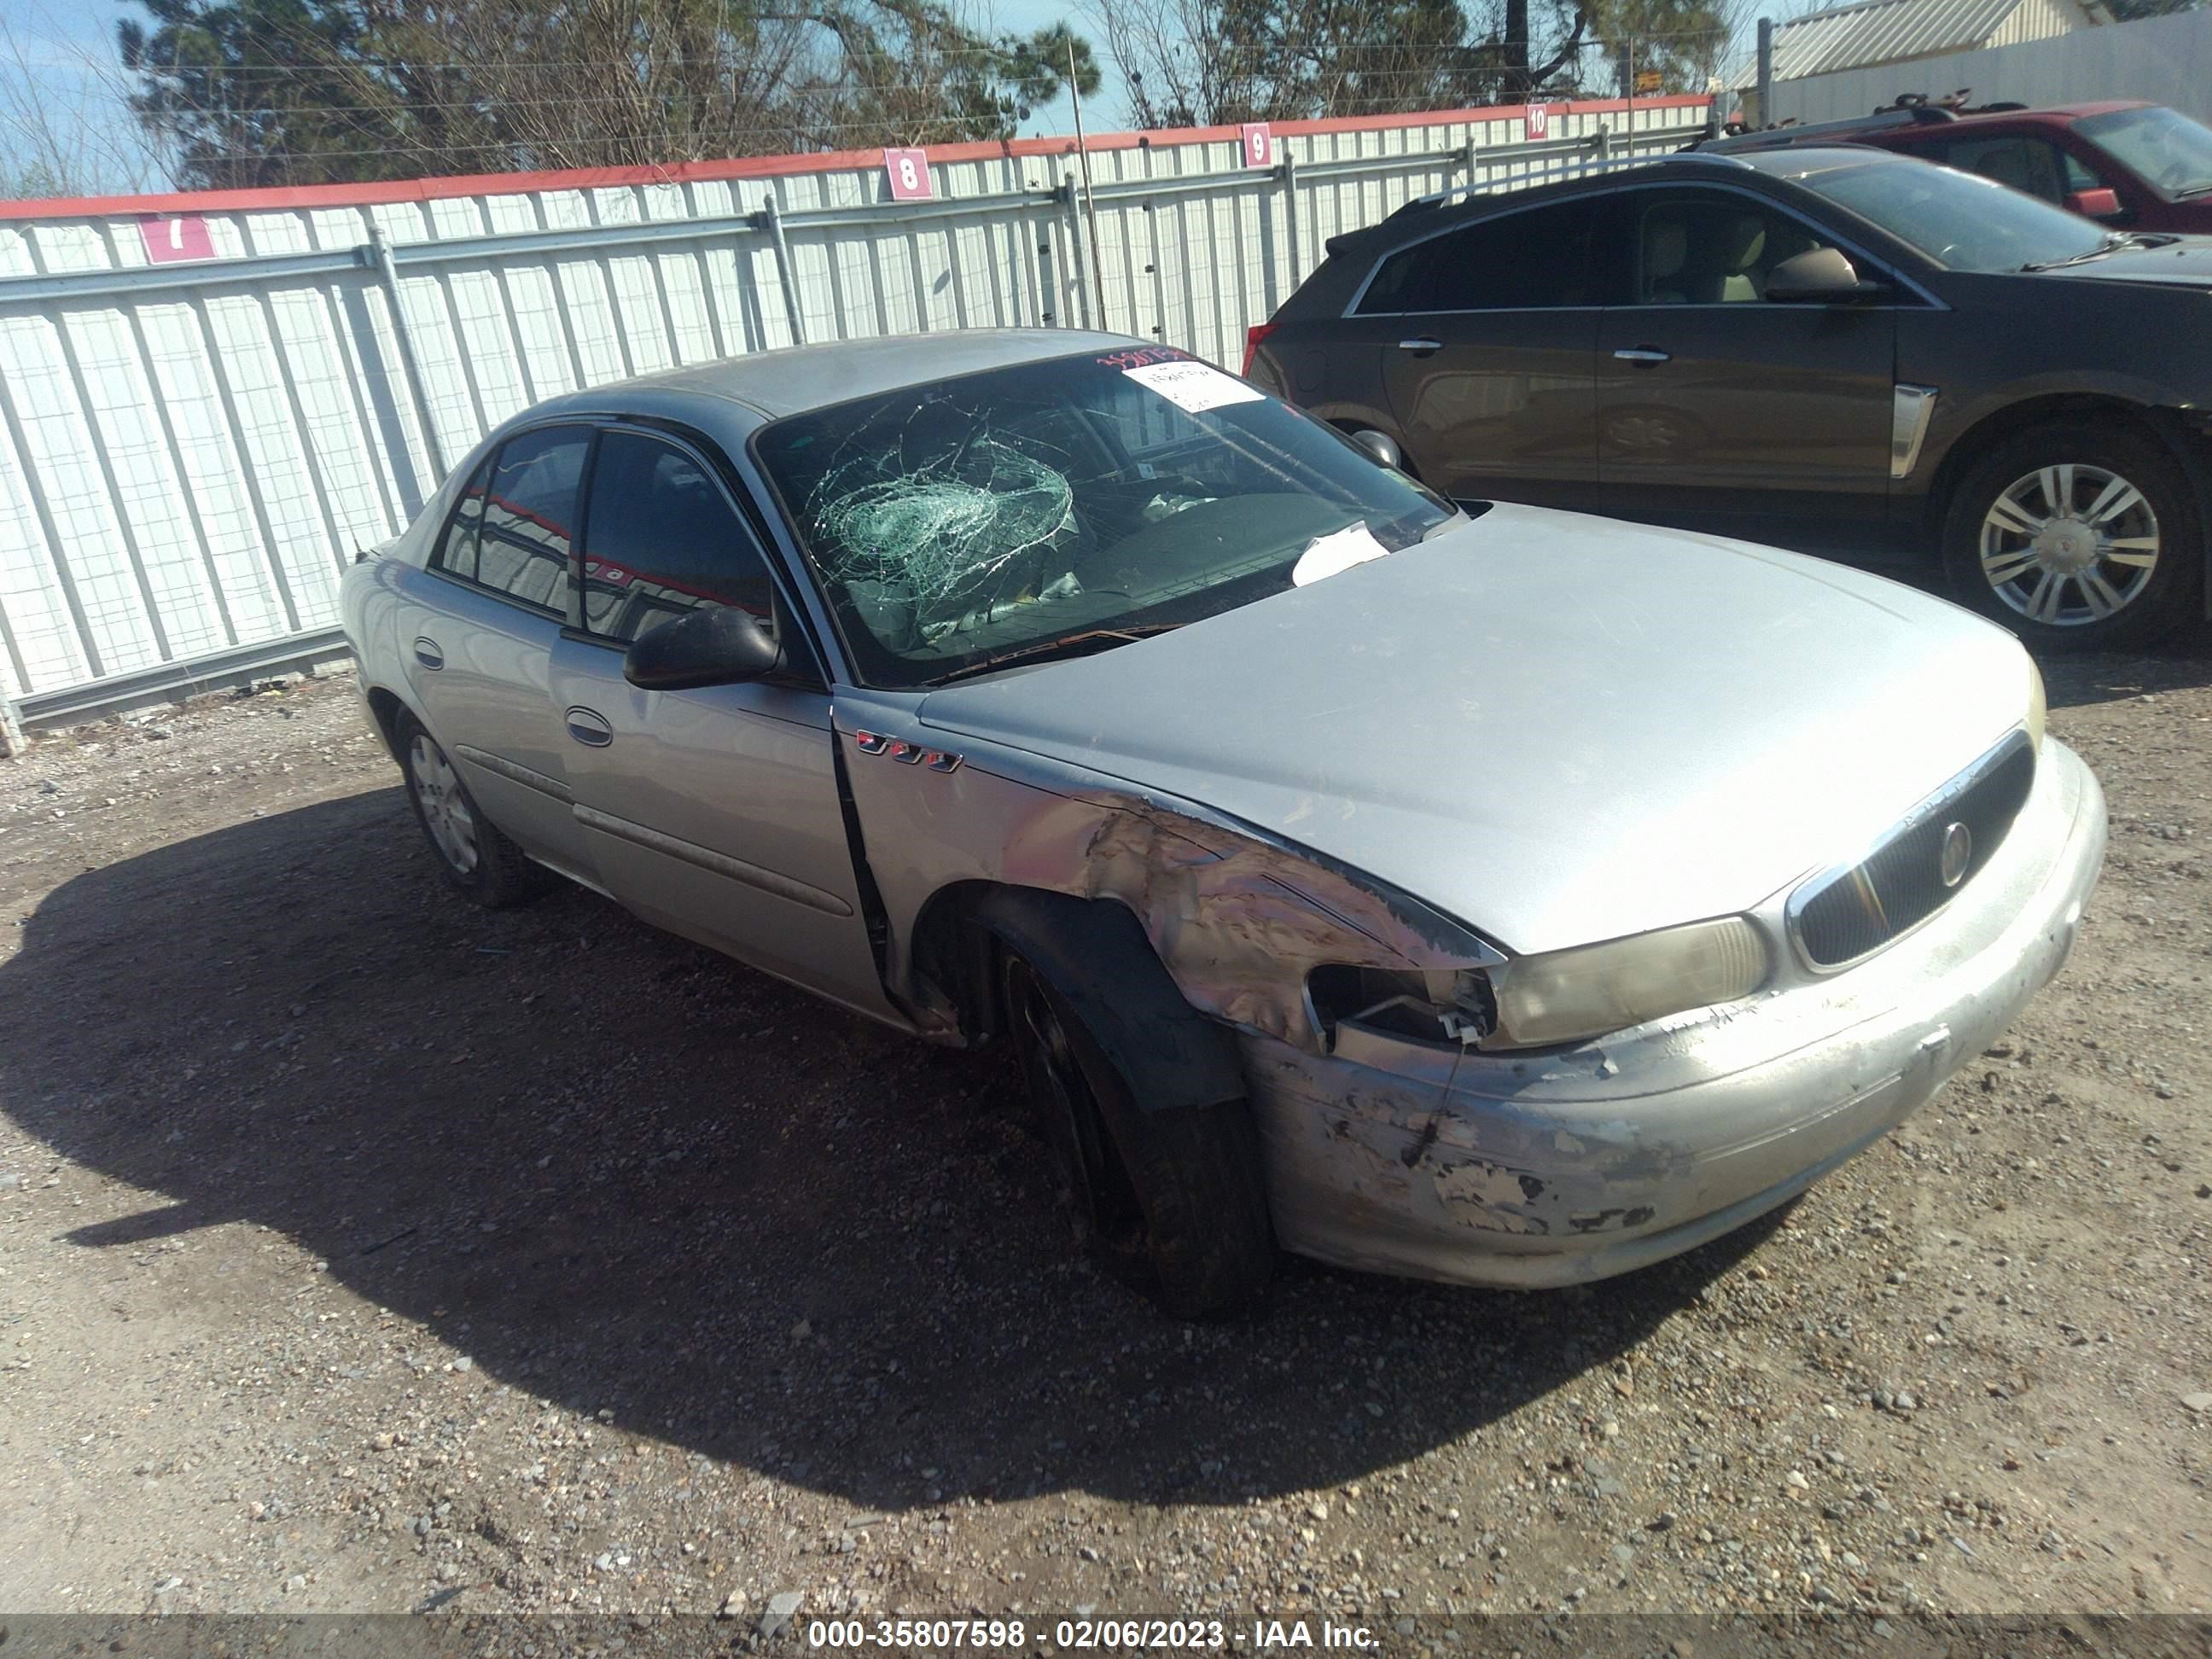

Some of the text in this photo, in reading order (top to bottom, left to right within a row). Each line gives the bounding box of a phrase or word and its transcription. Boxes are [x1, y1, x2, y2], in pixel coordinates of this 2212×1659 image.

[1530, 109, 1545, 133] 10
[1252, 132, 1264, 161] 9
[899, 158, 919, 190] 8
